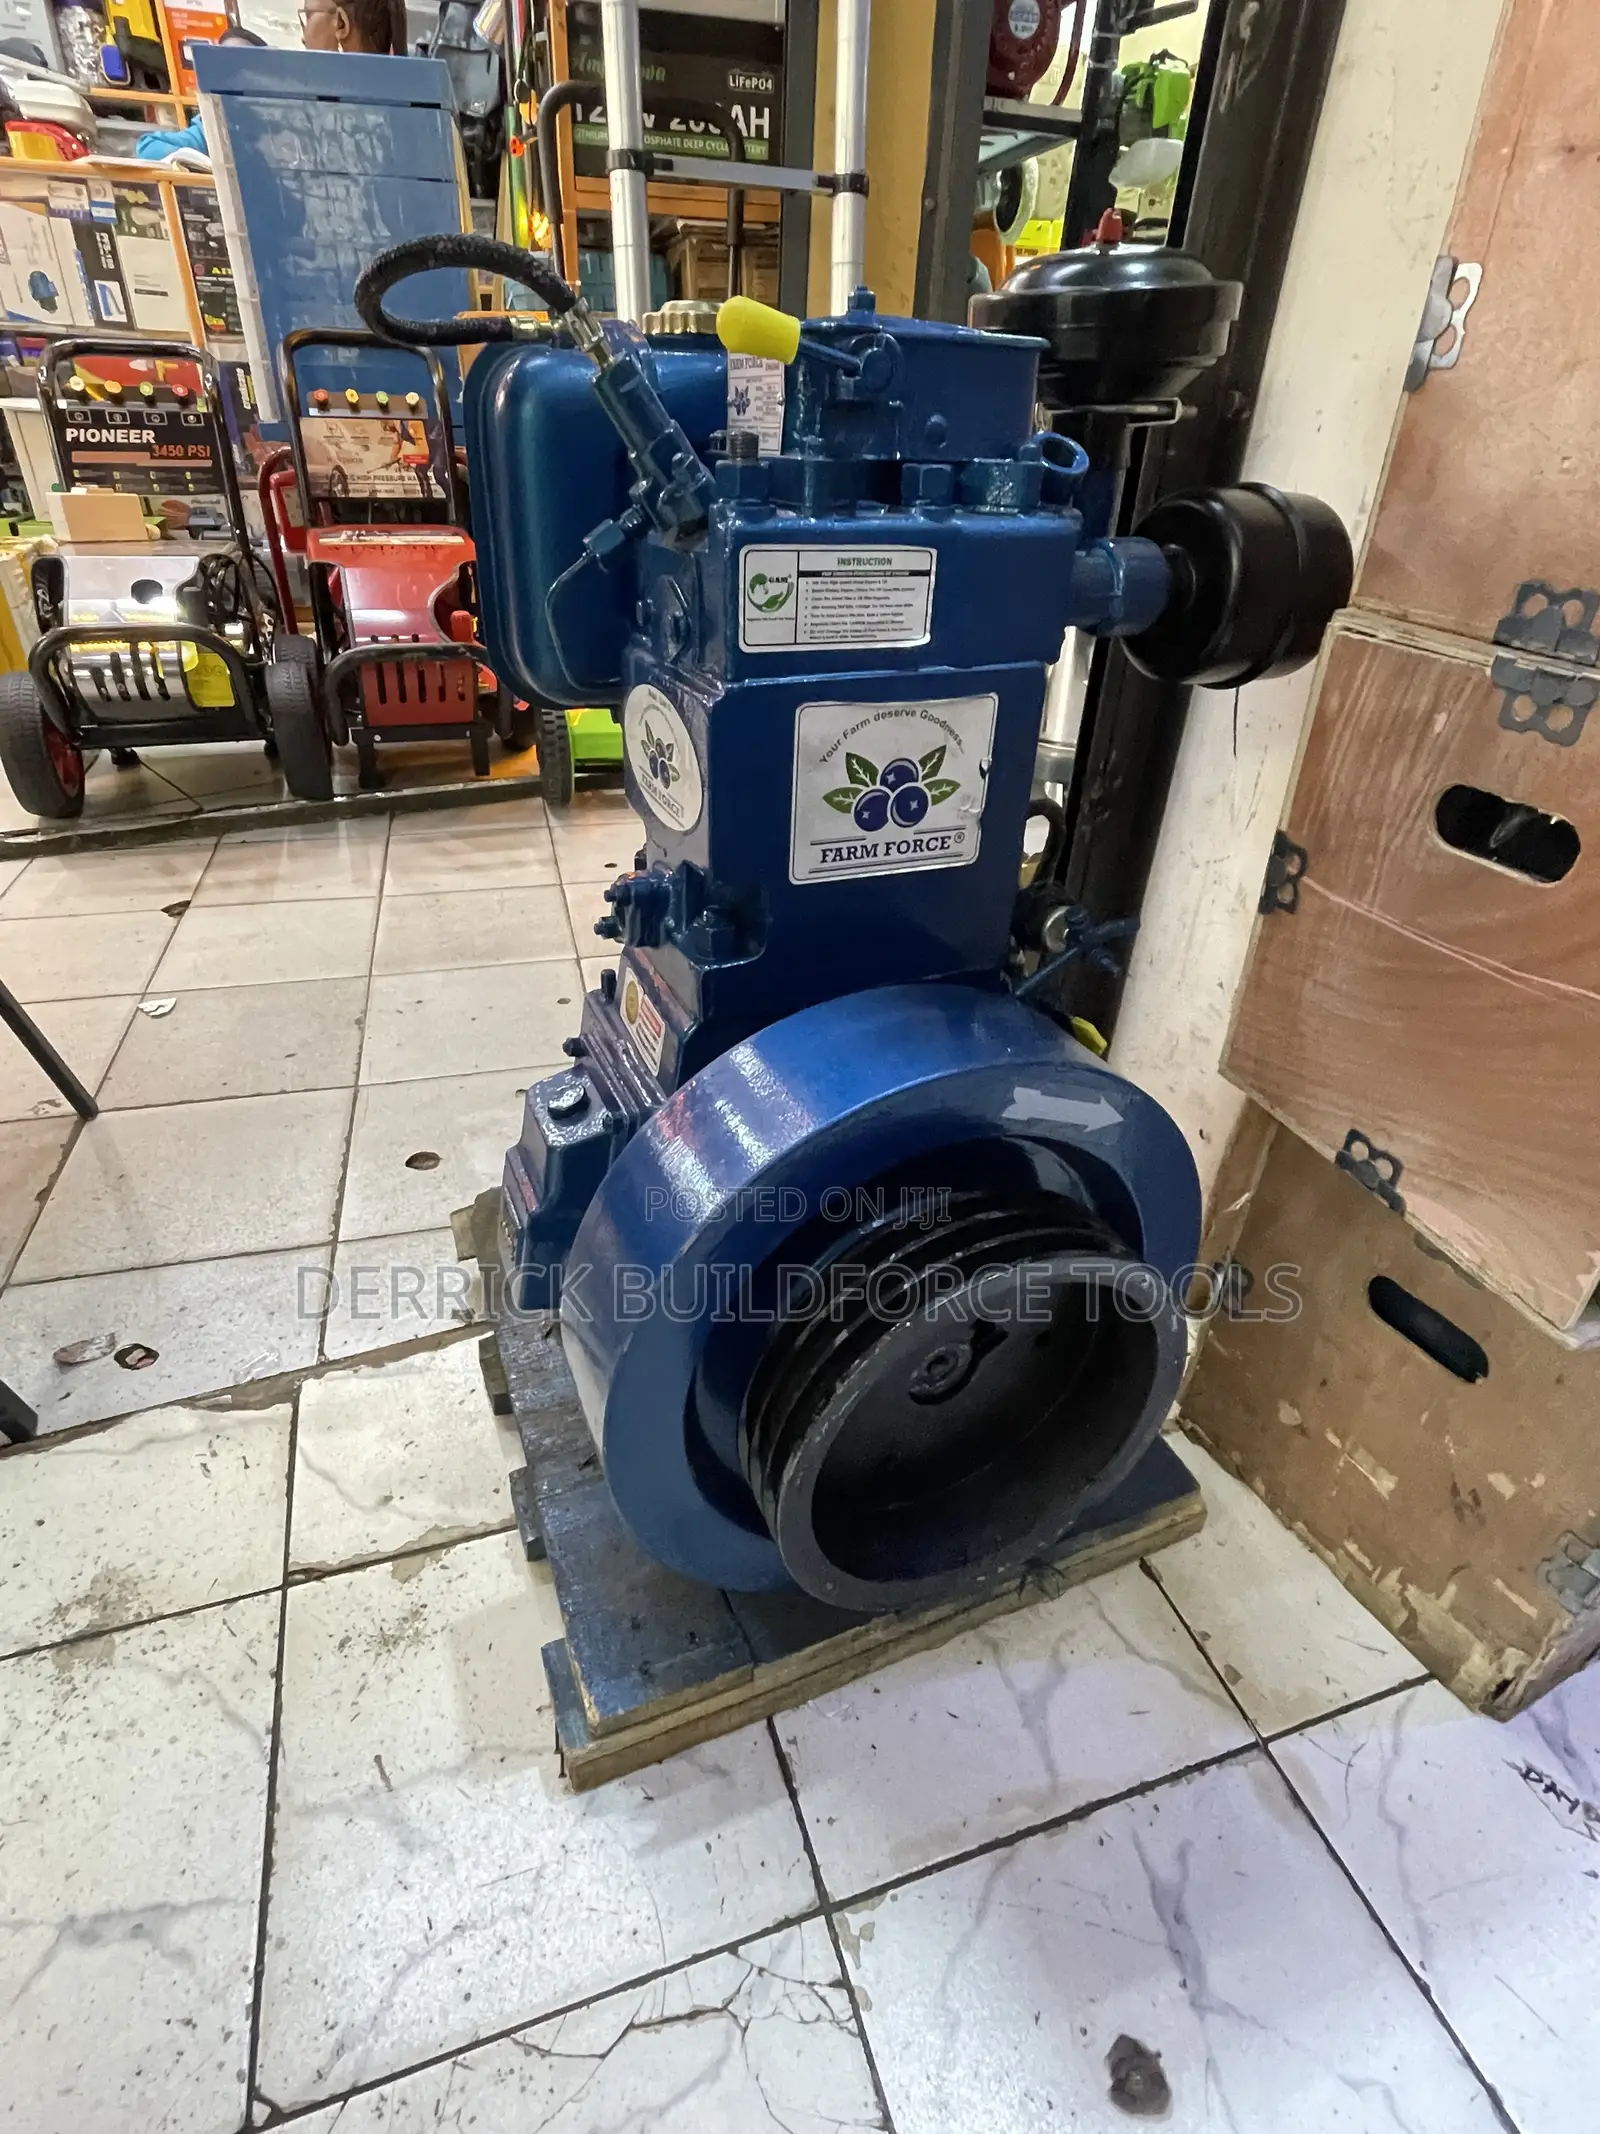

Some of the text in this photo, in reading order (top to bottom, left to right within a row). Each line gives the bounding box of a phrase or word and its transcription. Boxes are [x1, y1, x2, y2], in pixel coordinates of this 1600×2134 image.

[729, 75, 773, 91] LiFePO4
[683, 138, 705, 151] DEEP
[65, 427, 156, 444] PIONEER
[151, 444, 211, 458] 3450 PSI
[837, 556, 893, 567] INSTRUCTION
[818, 738, 843, 765] Your
[842, 718, 871, 742] Farm
[873, 708, 918, 723] deserve
[819, 842, 880, 864] FARM
